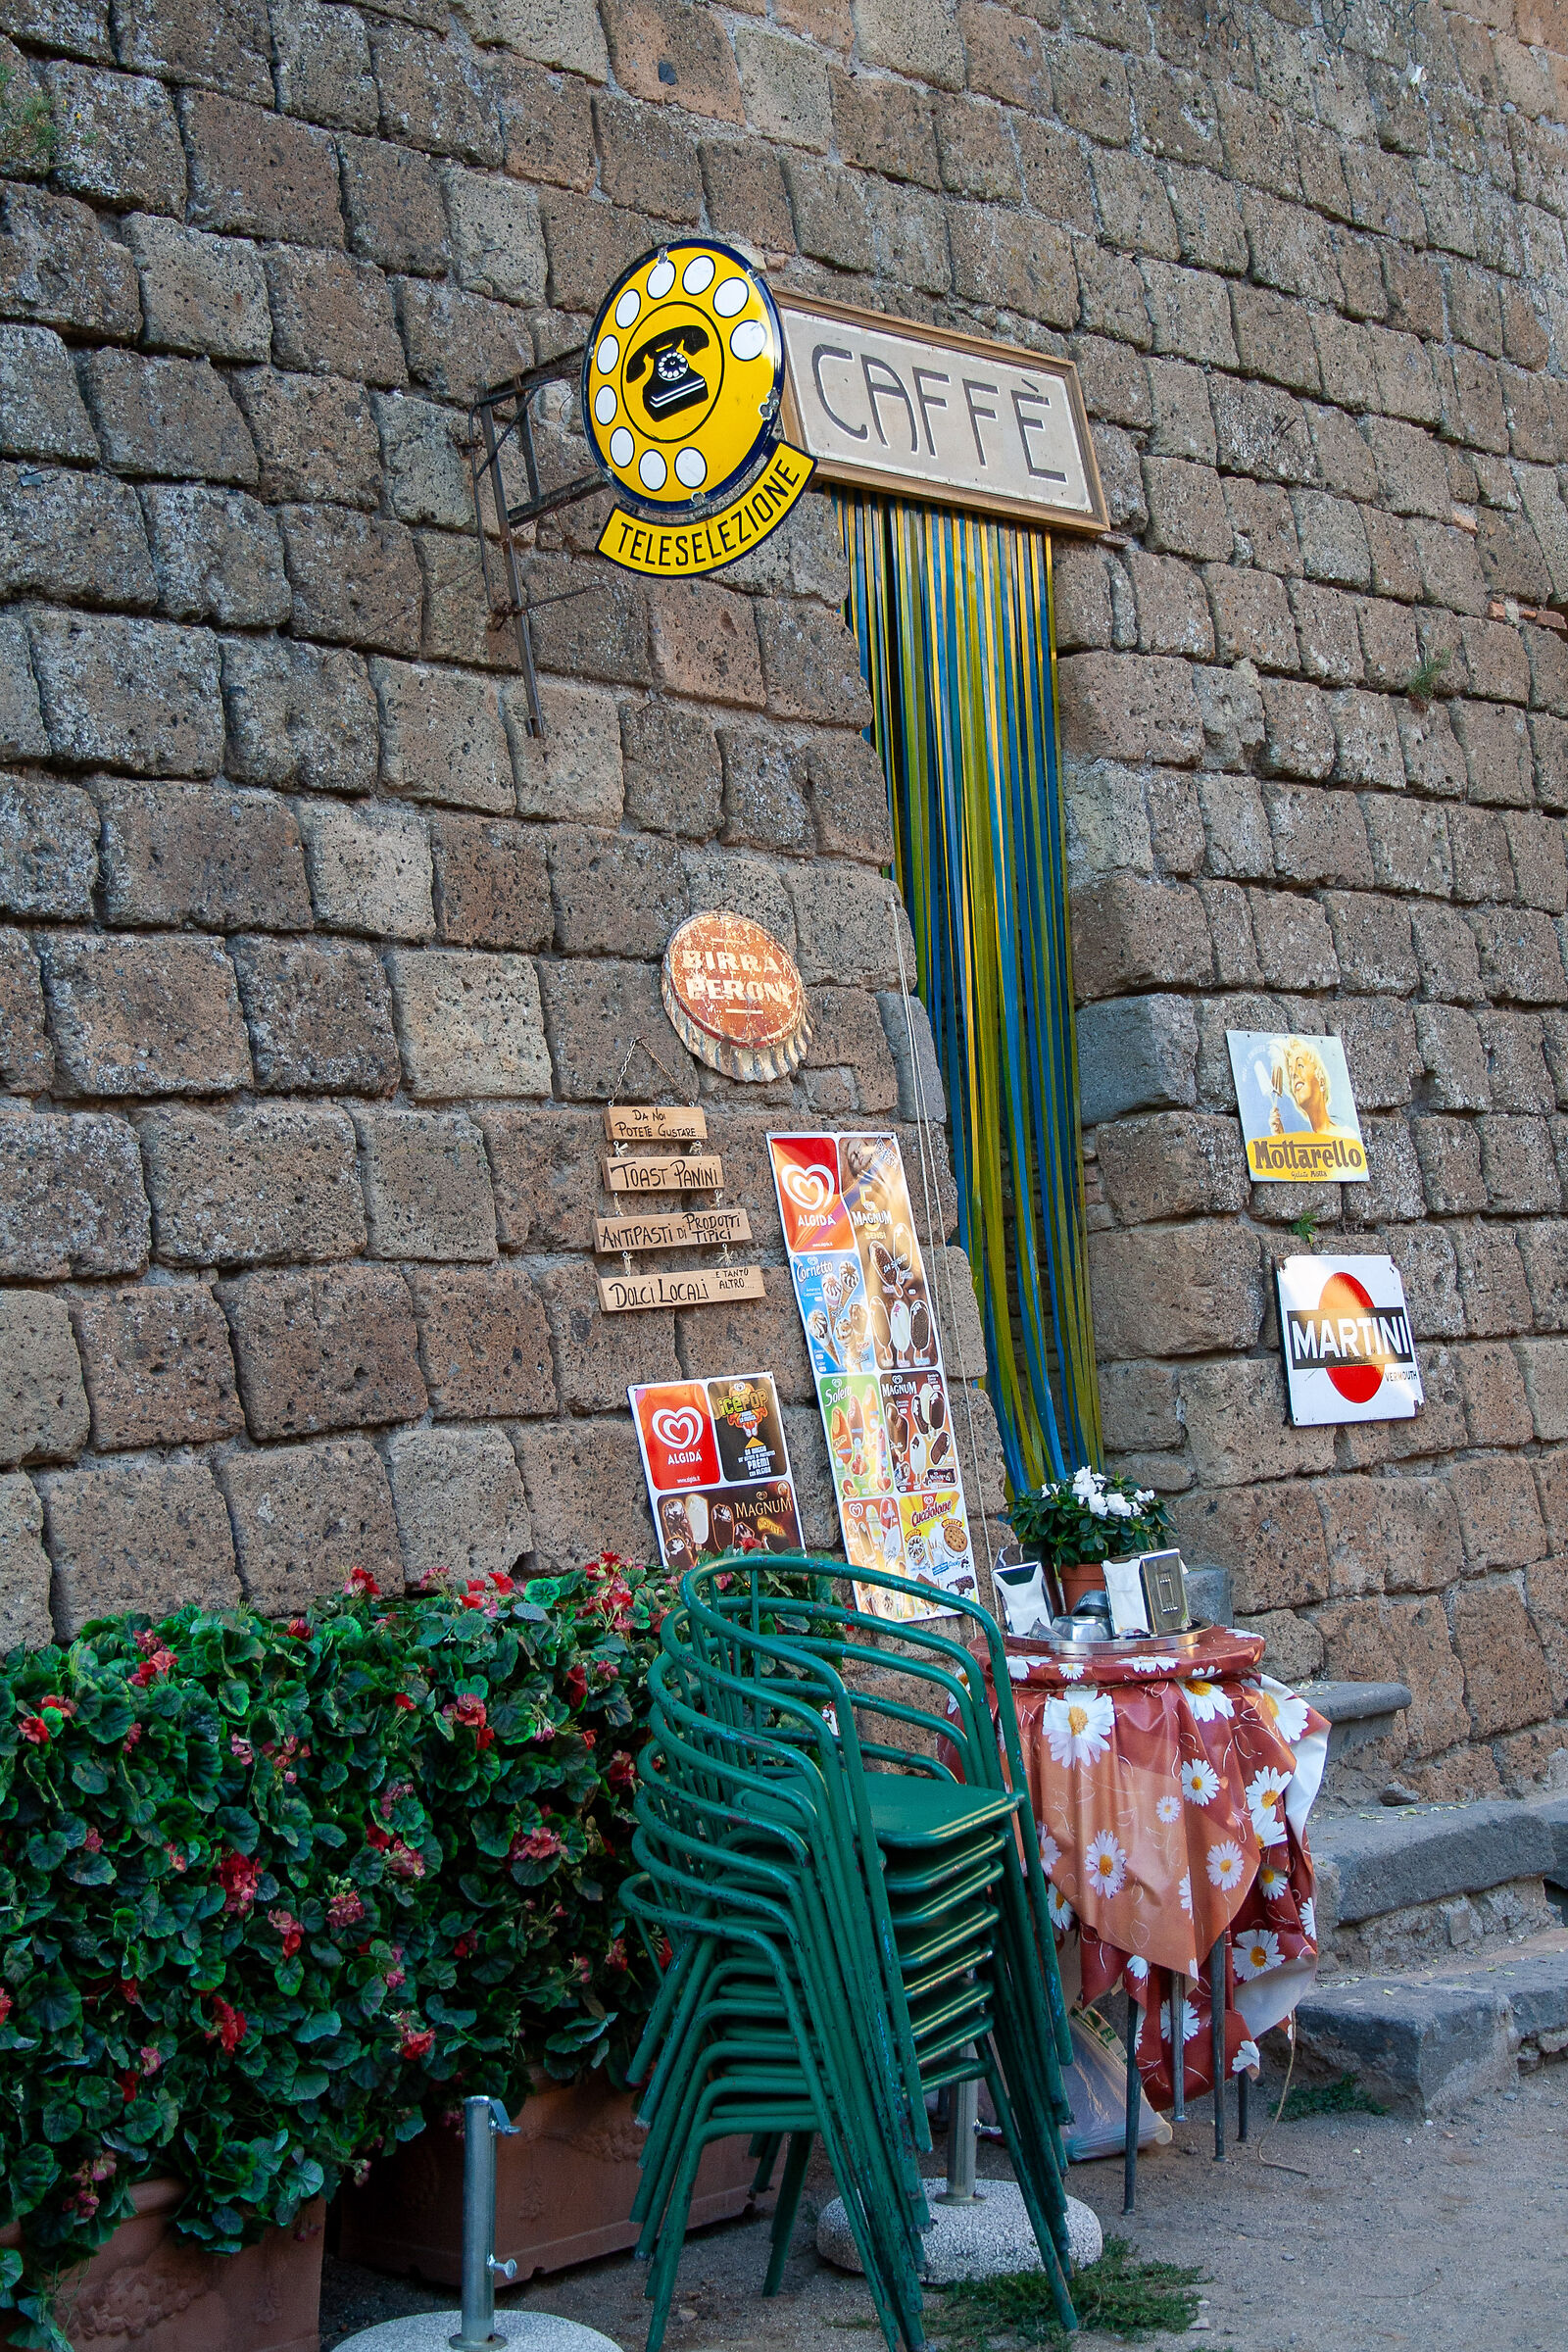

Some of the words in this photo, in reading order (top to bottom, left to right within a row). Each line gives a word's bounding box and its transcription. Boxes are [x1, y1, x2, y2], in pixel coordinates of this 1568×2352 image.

[811, 343, 1068, 484] CAFFÈ
[616, 459, 801, 567] TELESELEZIONE
[682, 950, 782, 974] BIRRA
[632, 1108, 649, 1121] DA
[652, 1107, 666, 1122] NOI
[614, 1121, 653, 1137] POTETE
[1253, 1140, 1362, 1169] Mottarello
[610, 1161, 668, 1189] TOAST
[798, 1213, 837, 1227] ALGIDA
[852, 1210, 893, 1226] MAGNUM
[722, 1267, 749, 1278] TANTO
[796, 1259, 833, 1283] Cornetto
[1291, 1316, 1411, 1360] MARTINI
[1385, 1370, 1418, 1383] VERMOUTH
[825, 1385, 853, 1407] Solero
[882, 1381, 918, 1397] MAGNUM
[667, 1449, 703, 1465] ALGIDA
[735, 1497, 792, 1519] MAGNUM
[911, 1499, 952, 1528] Cucciolone
